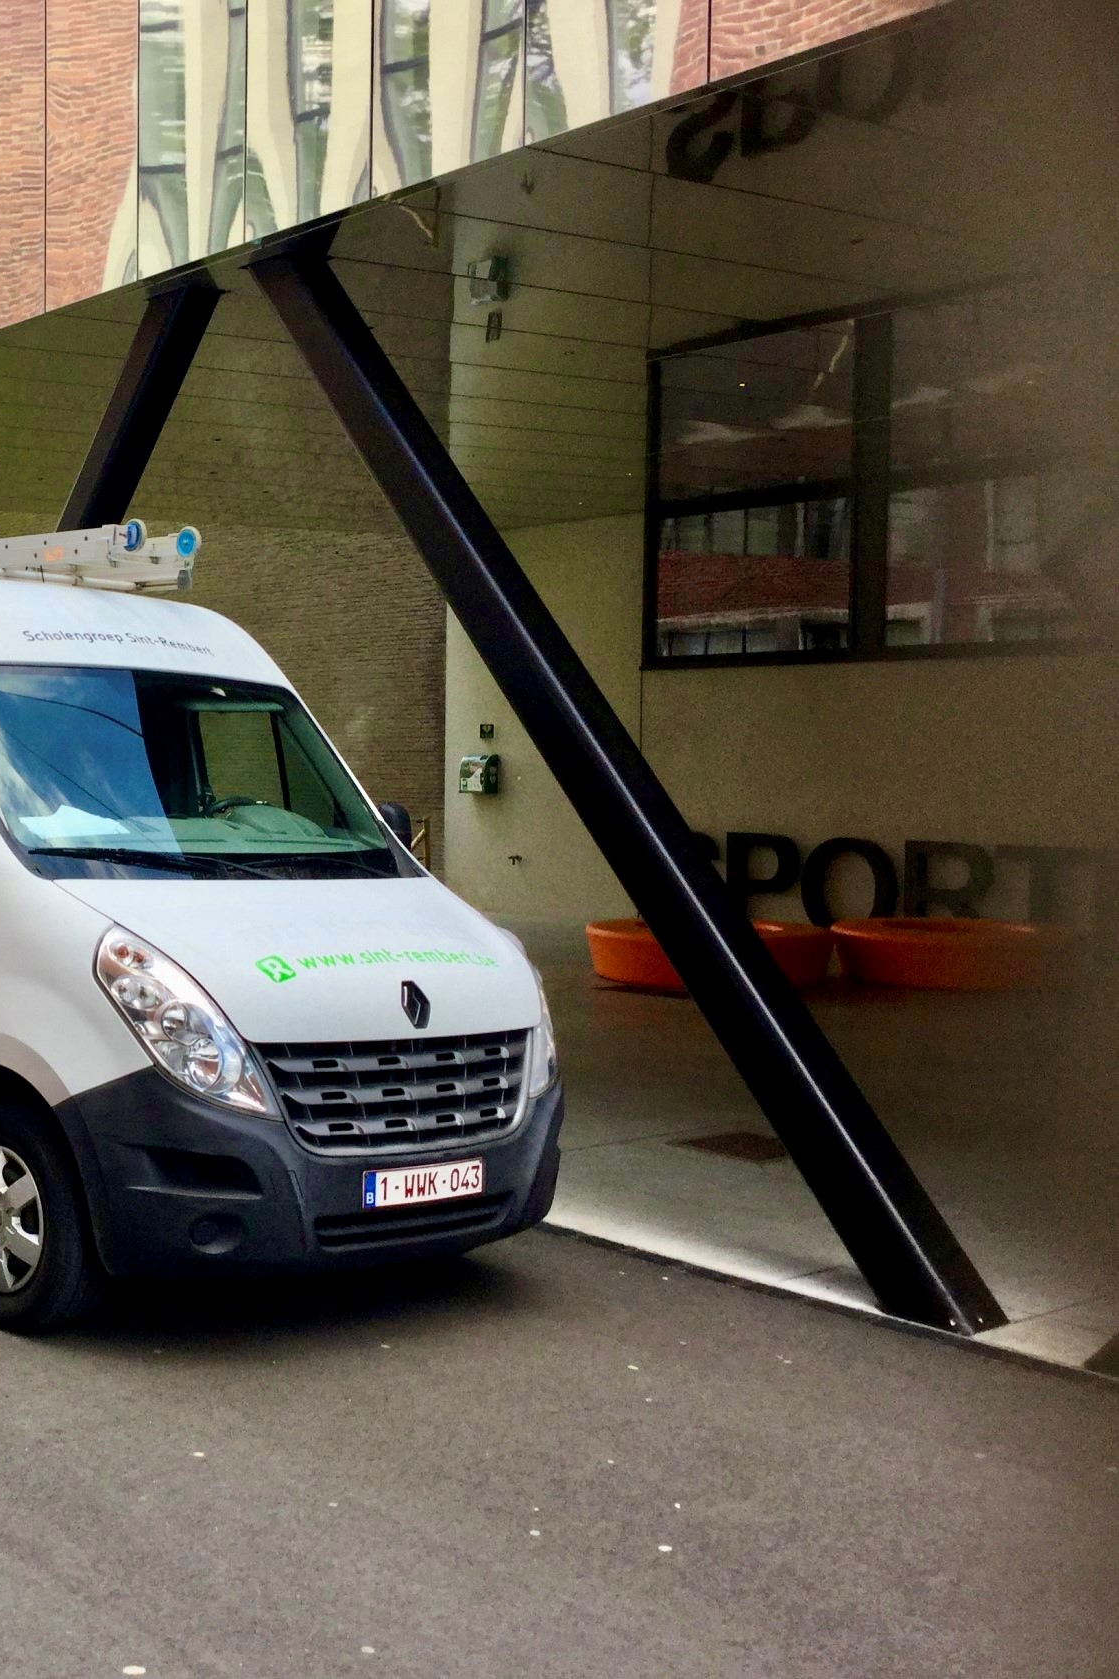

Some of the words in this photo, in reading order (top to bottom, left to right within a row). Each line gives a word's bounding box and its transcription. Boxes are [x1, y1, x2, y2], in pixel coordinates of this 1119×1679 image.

[22, 630, 124, 644] Scholengroep
[125, 632, 215, 656] Sint-Rembert
[296, 947, 499, 969] www.sint-rembert.be
[366, 1192, 376, 1204] B
